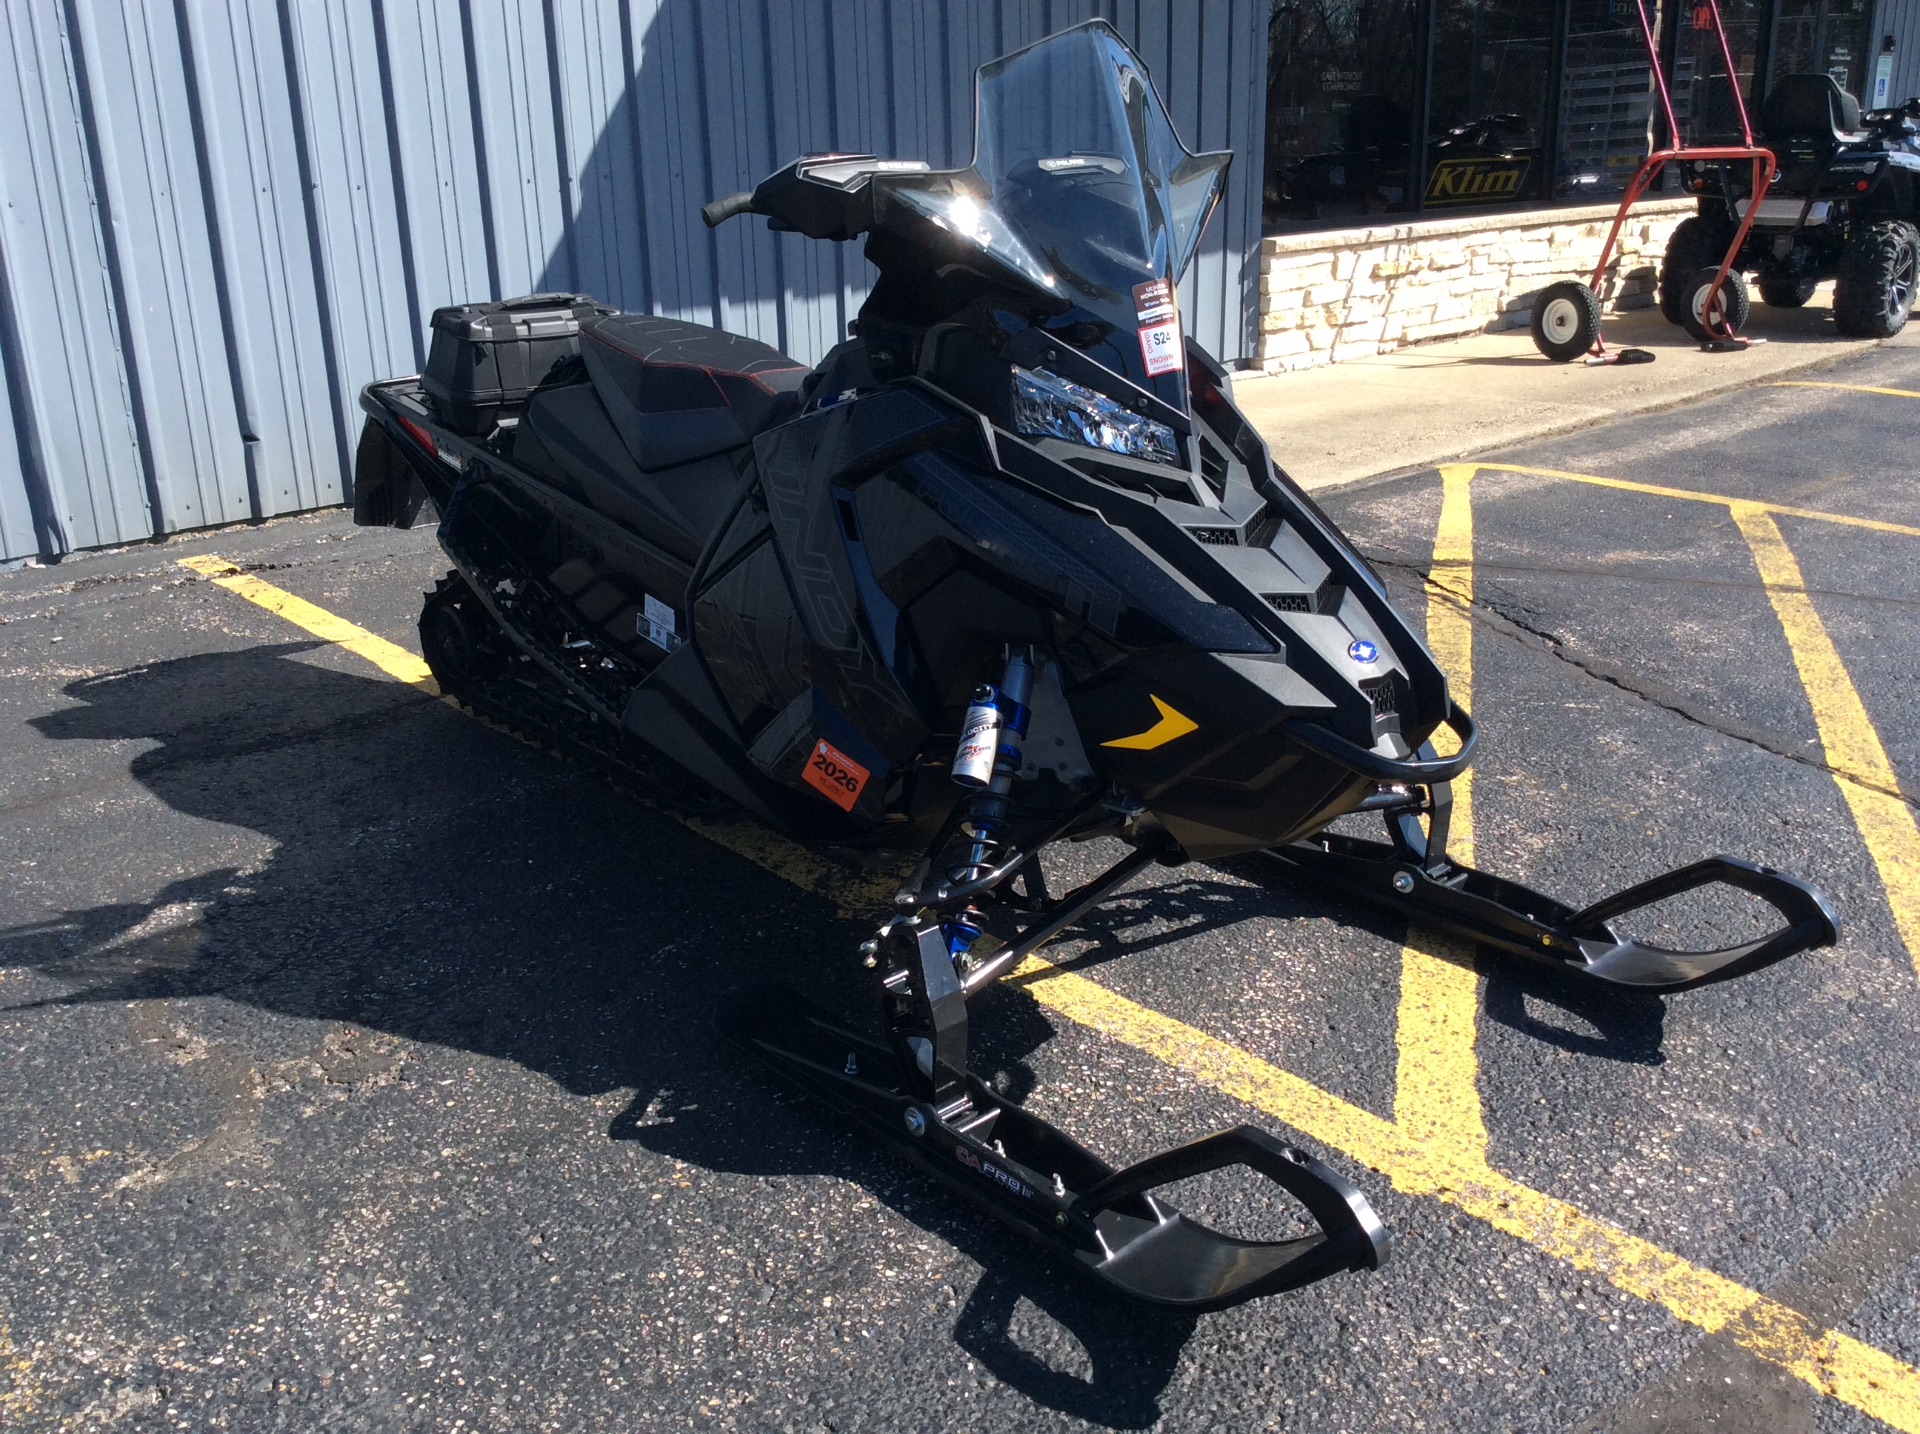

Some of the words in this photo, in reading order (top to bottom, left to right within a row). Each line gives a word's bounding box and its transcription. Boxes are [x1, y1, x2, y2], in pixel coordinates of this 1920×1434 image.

[1430, 166, 1519, 197] Klim
[1145, 331, 1153, 353] IDAHO
[812, 754, 859, 793] 2026
